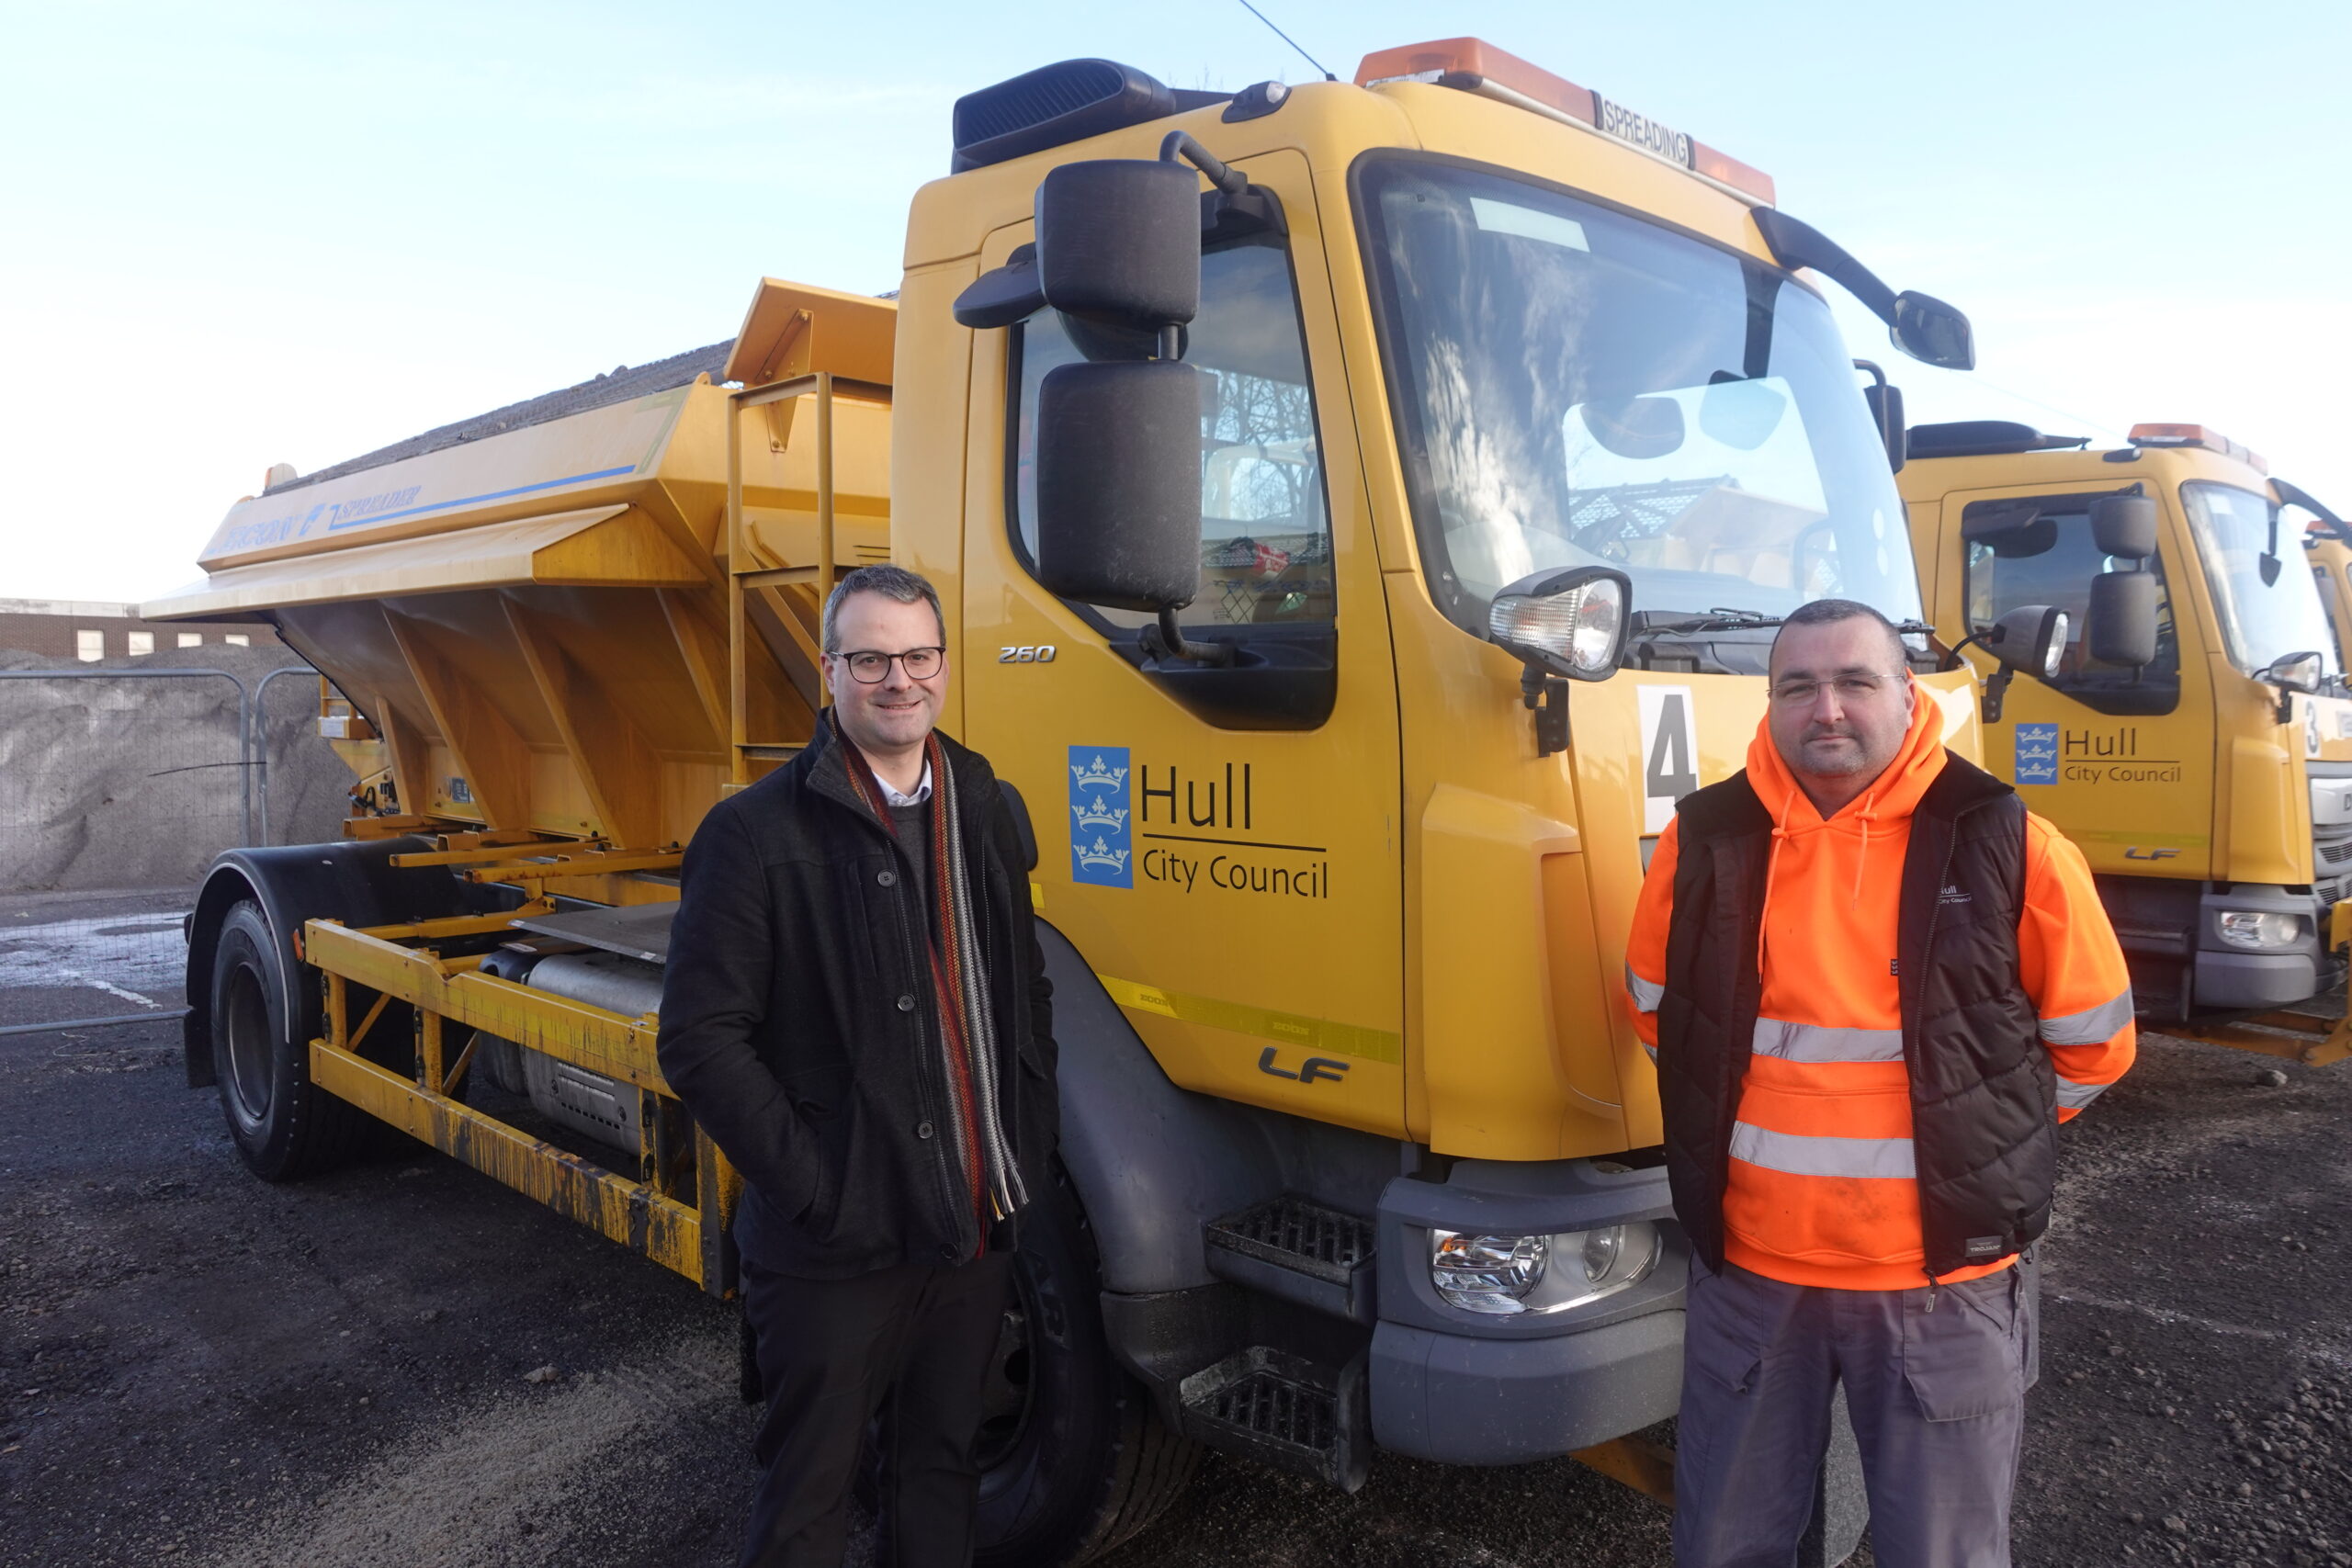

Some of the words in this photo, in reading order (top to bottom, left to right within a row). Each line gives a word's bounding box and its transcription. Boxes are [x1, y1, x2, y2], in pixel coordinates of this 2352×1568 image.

[1604, 99, 1687, 164] SPREADING
[998, 645, 1057, 663] 260
[2064, 728, 2136, 756] Hull
[2306, 700, 2319, 753] 3
[1646, 694, 1697, 810] 4
[1141, 762, 1251, 830] Hull
[2064, 766, 2102, 784] City
[2109, 766, 2182, 783] Council
[1143, 849, 1199, 894] City
[1209, 855, 1328, 899] Council
[2124, 846, 2182, 861] LF
[1258, 1045, 1351, 1084] LF
